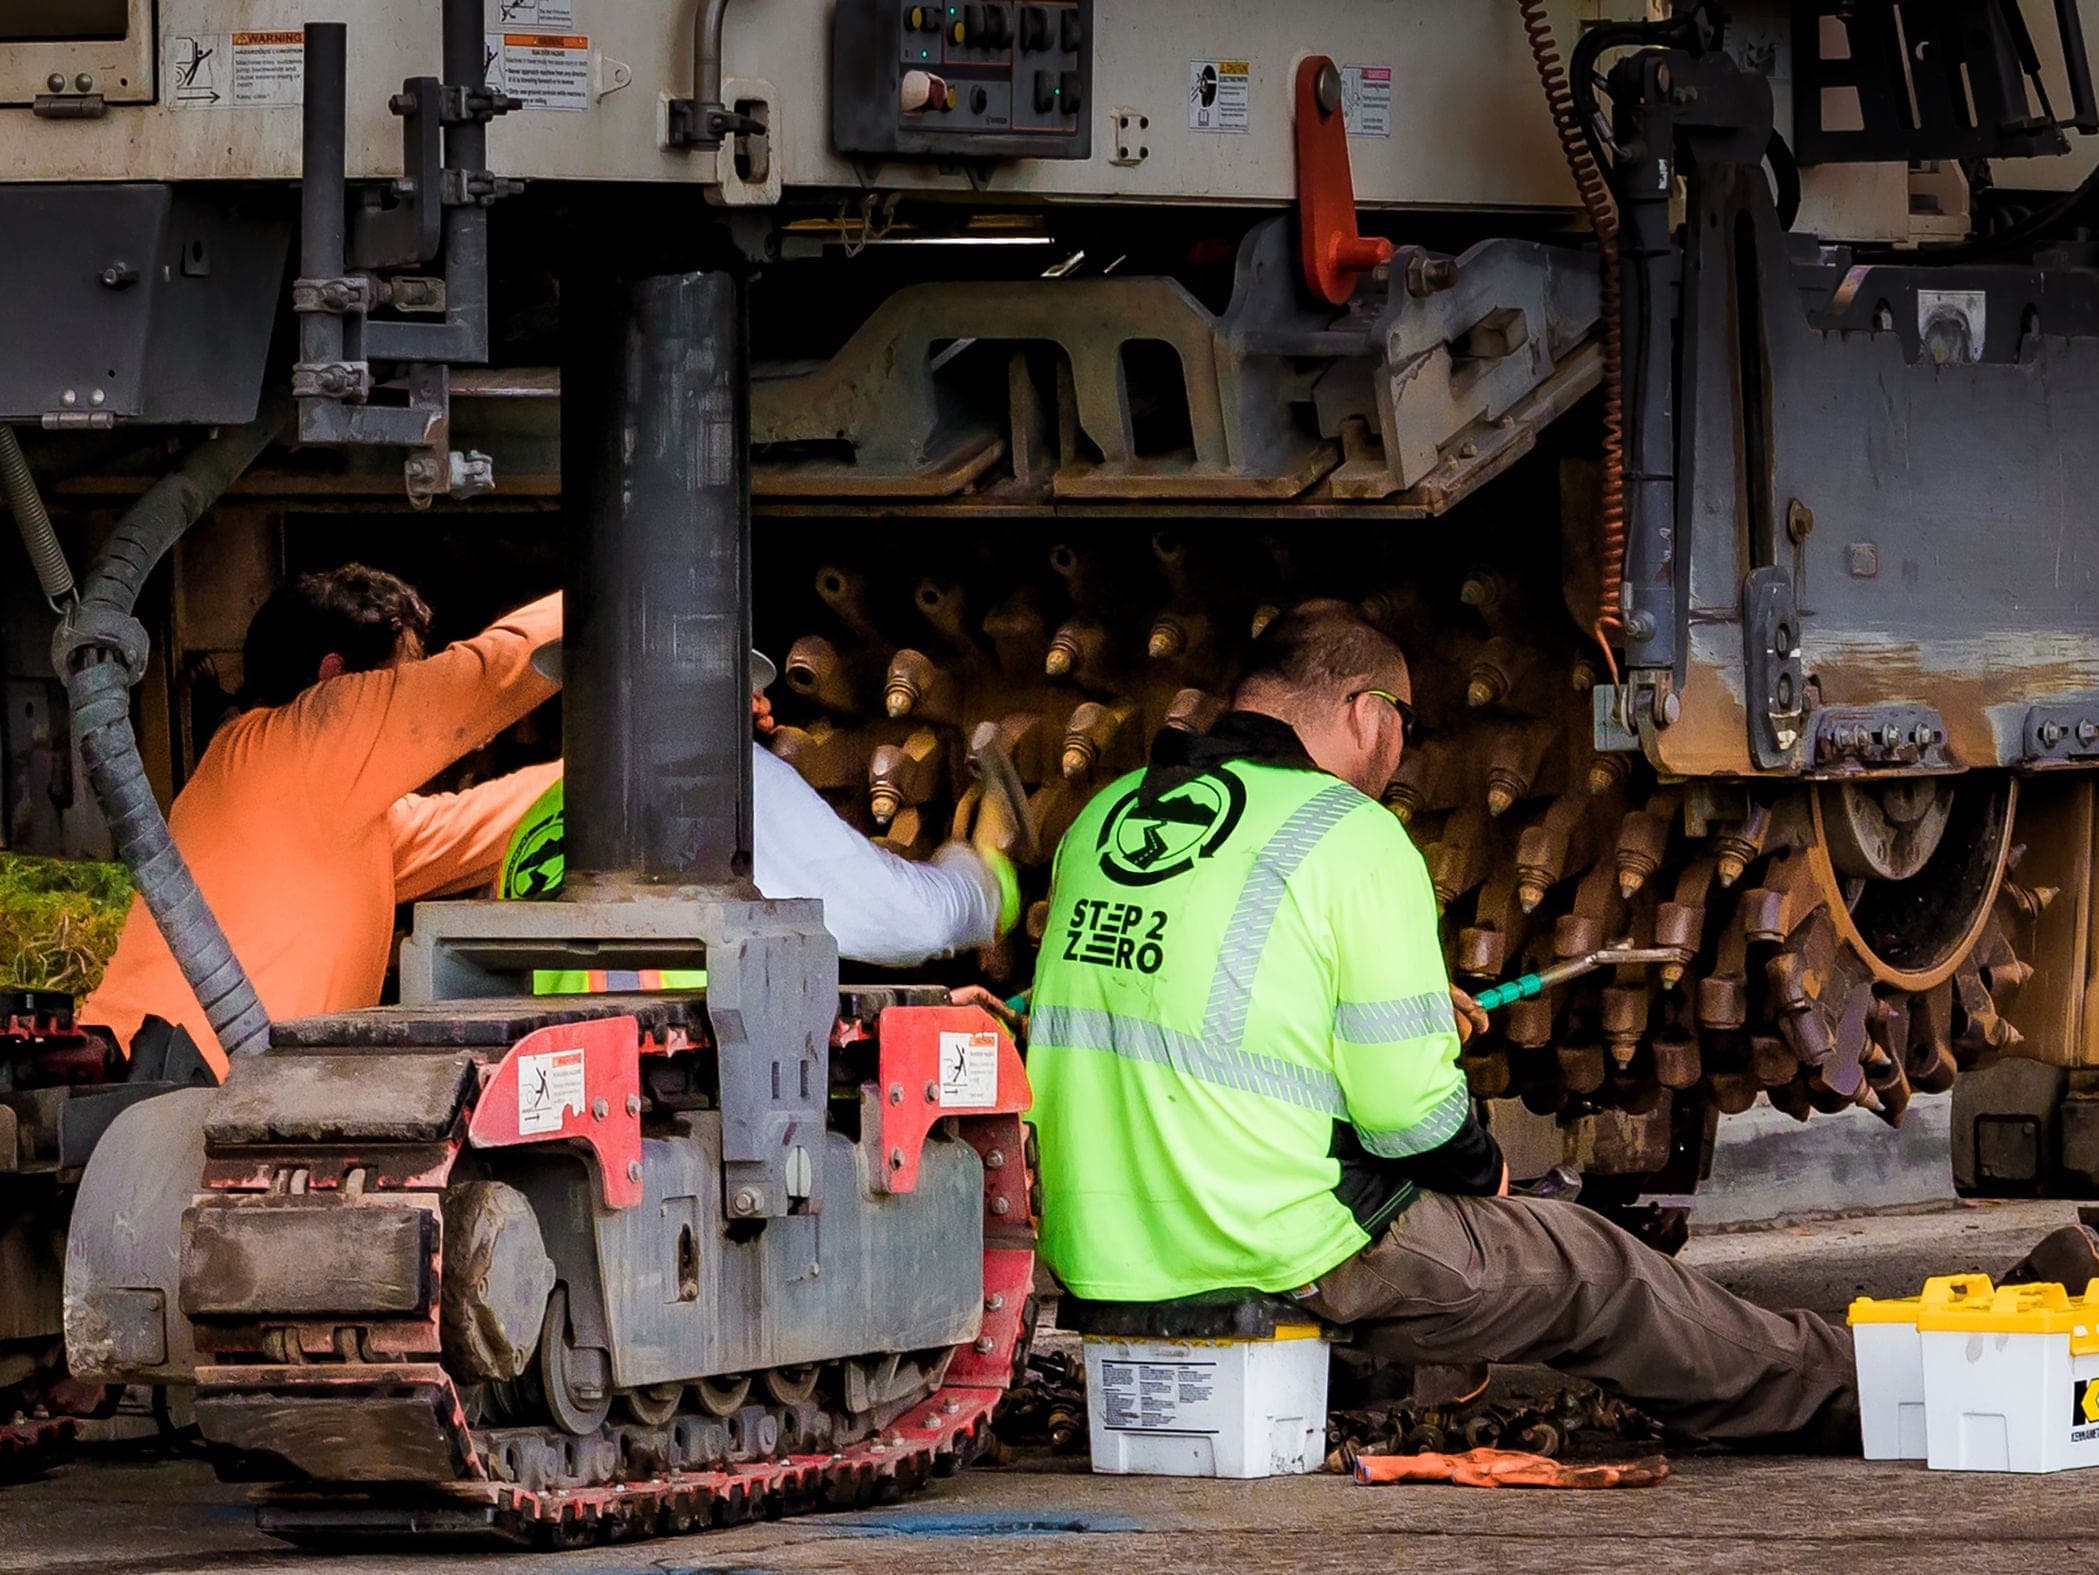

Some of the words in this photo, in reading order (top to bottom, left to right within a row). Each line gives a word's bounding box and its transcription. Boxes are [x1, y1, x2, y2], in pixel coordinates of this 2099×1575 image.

[248, 33, 302, 44] WARNING
[1069, 898, 1143, 935] STEP
[1145, 910, 1168, 941] 2
[1062, 930, 1164, 975] ZERO
